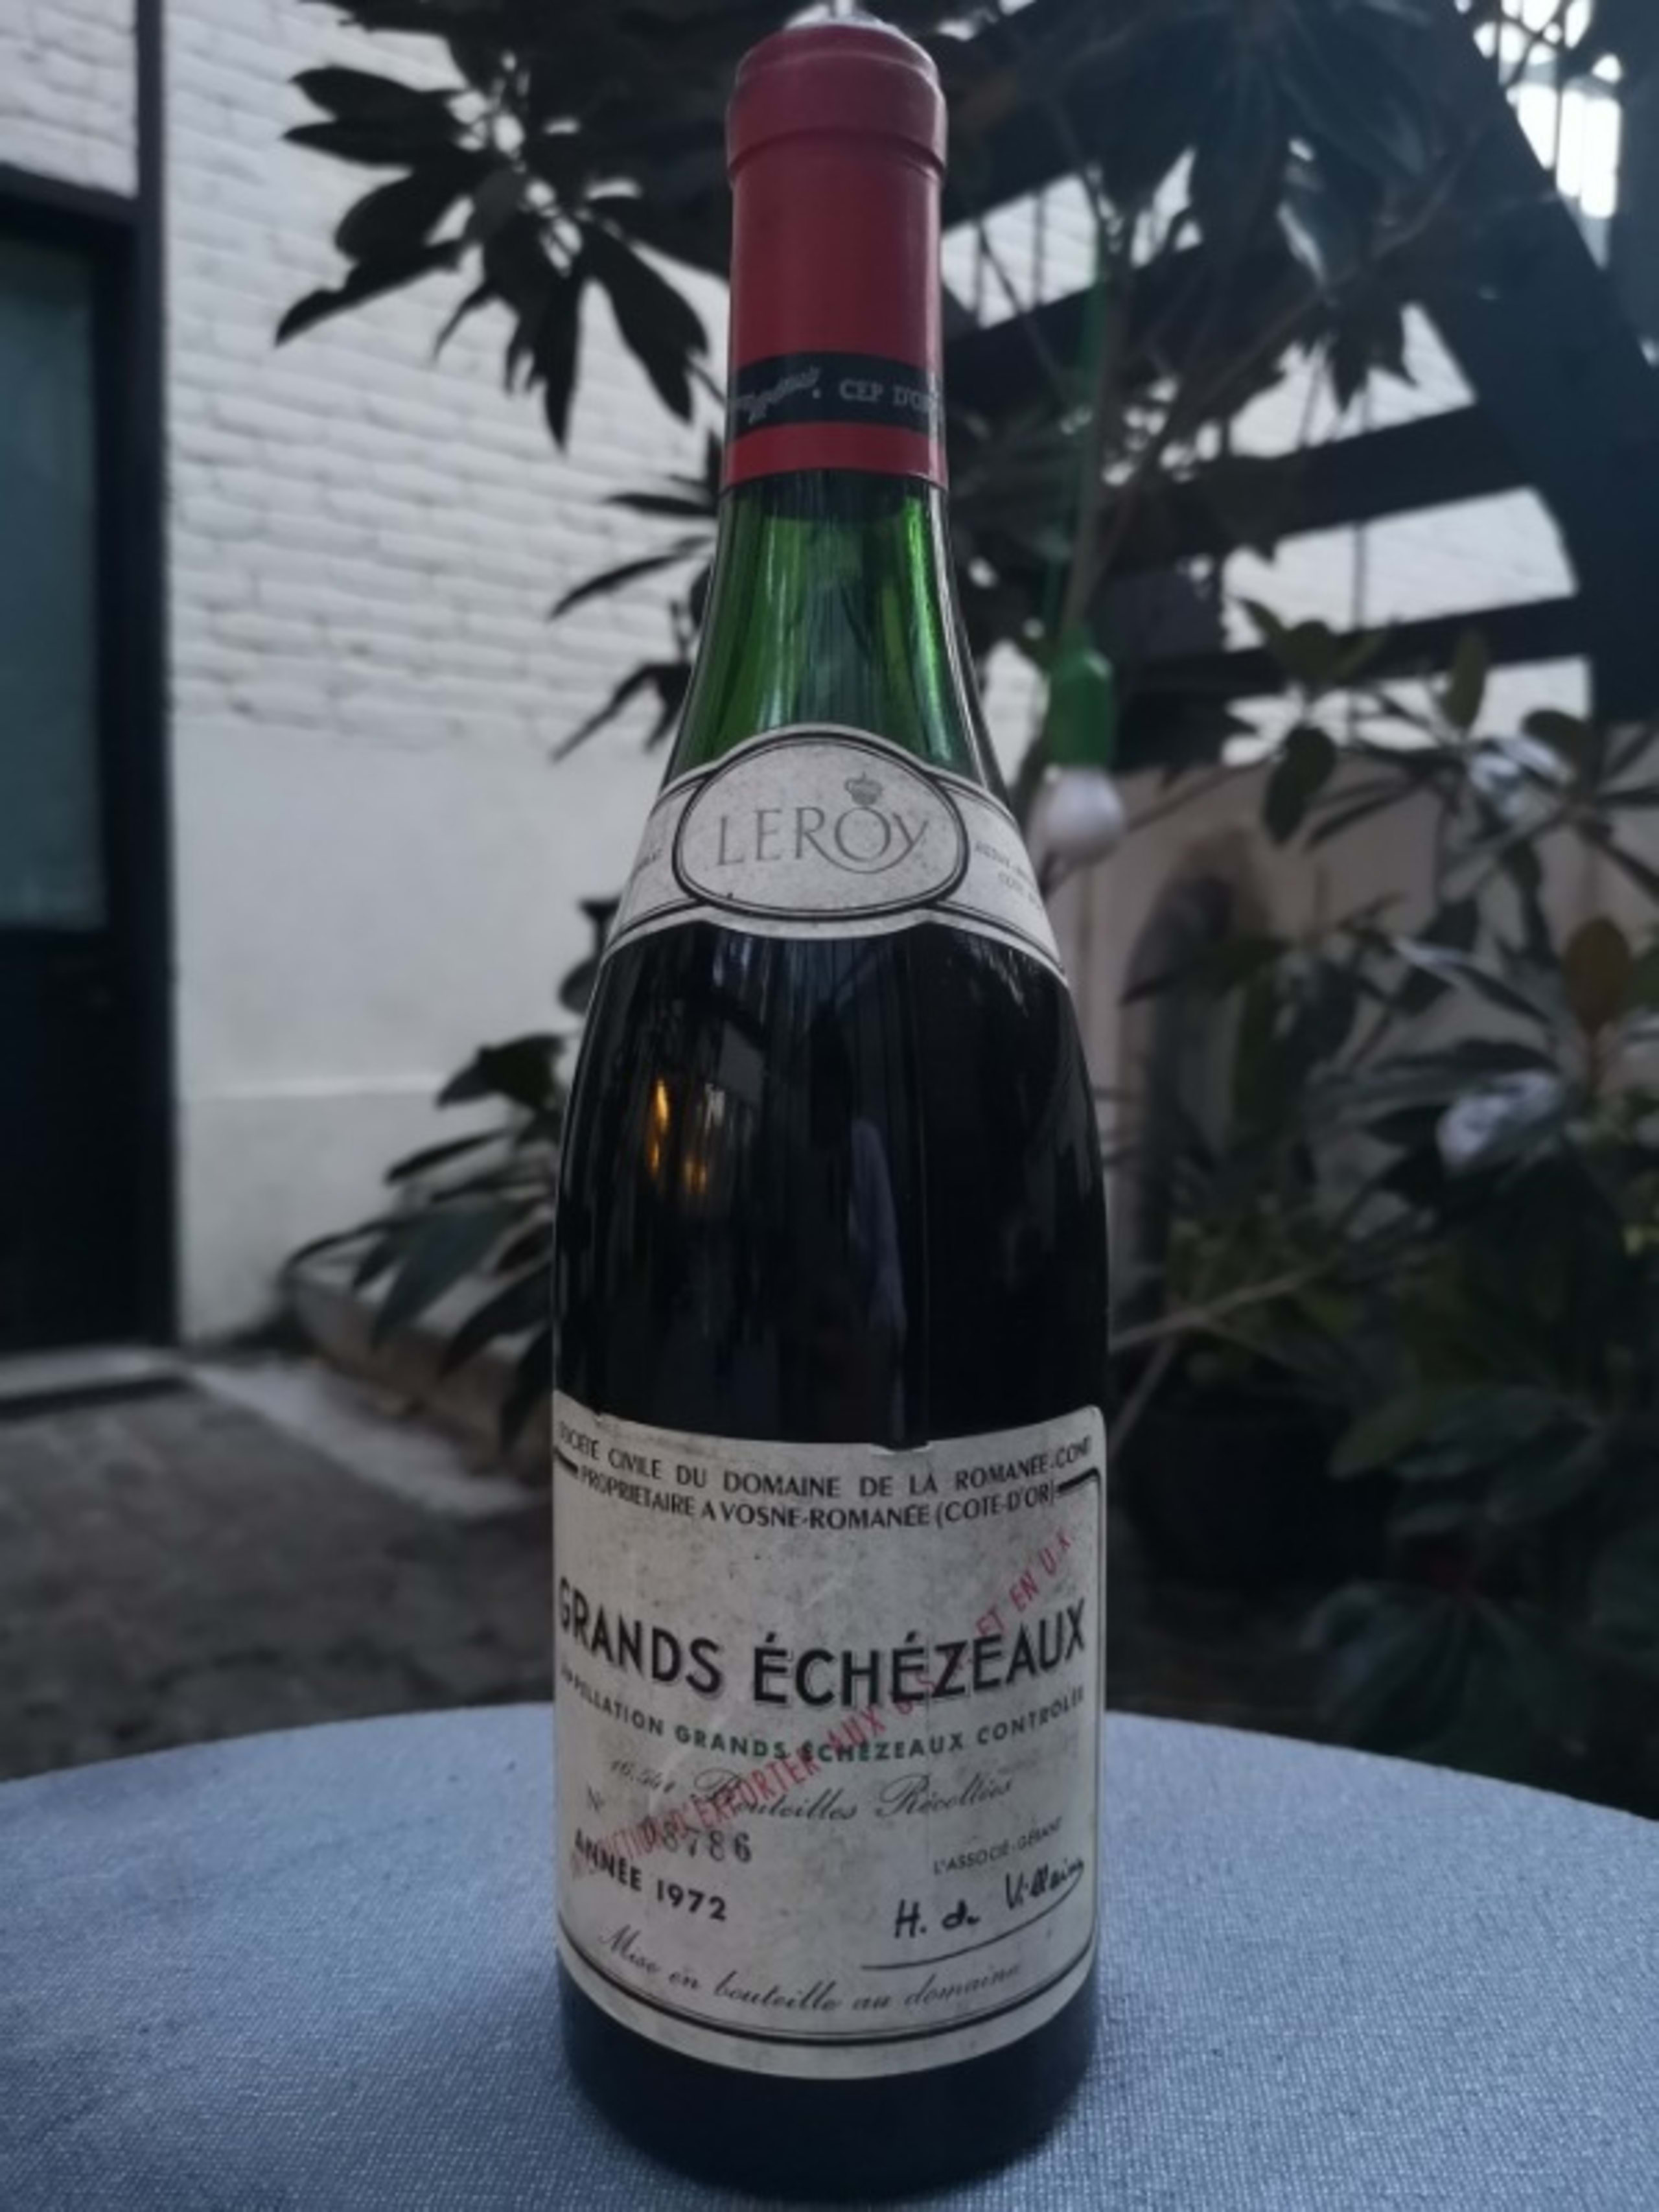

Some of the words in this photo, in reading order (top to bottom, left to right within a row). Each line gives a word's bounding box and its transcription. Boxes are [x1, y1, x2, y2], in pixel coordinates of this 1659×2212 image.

[715, 806, 929, 874] LEROY
[607, 1447, 662, 1480] CIVILE
[675, 1464, 708, 1488] DU
[723, 1471, 841, 1498] DOMAINE
[859, 1476, 893, 1498] DE
[909, 1473, 939, 1494] LA
[977, 1605, 1004, 1637] ET
[1009, 1569, 1039, 1613] EN
[559, 1576, 723, 1696] GRANDS
[753, 1598, 1086, 1707] ÉCHÉZEAUX
[675, 1725, 787, 1759] GRANDS
[656, 1878, 727, 1922] 1972
[596, 1924, 659, 1973] Mise
[667, 1970, 700, 1990] en
[712, 1970, 842, 2011] bouteille
[852, 1995, 892, 2011] au
[903, 1964, 1021, 2005] domaine
